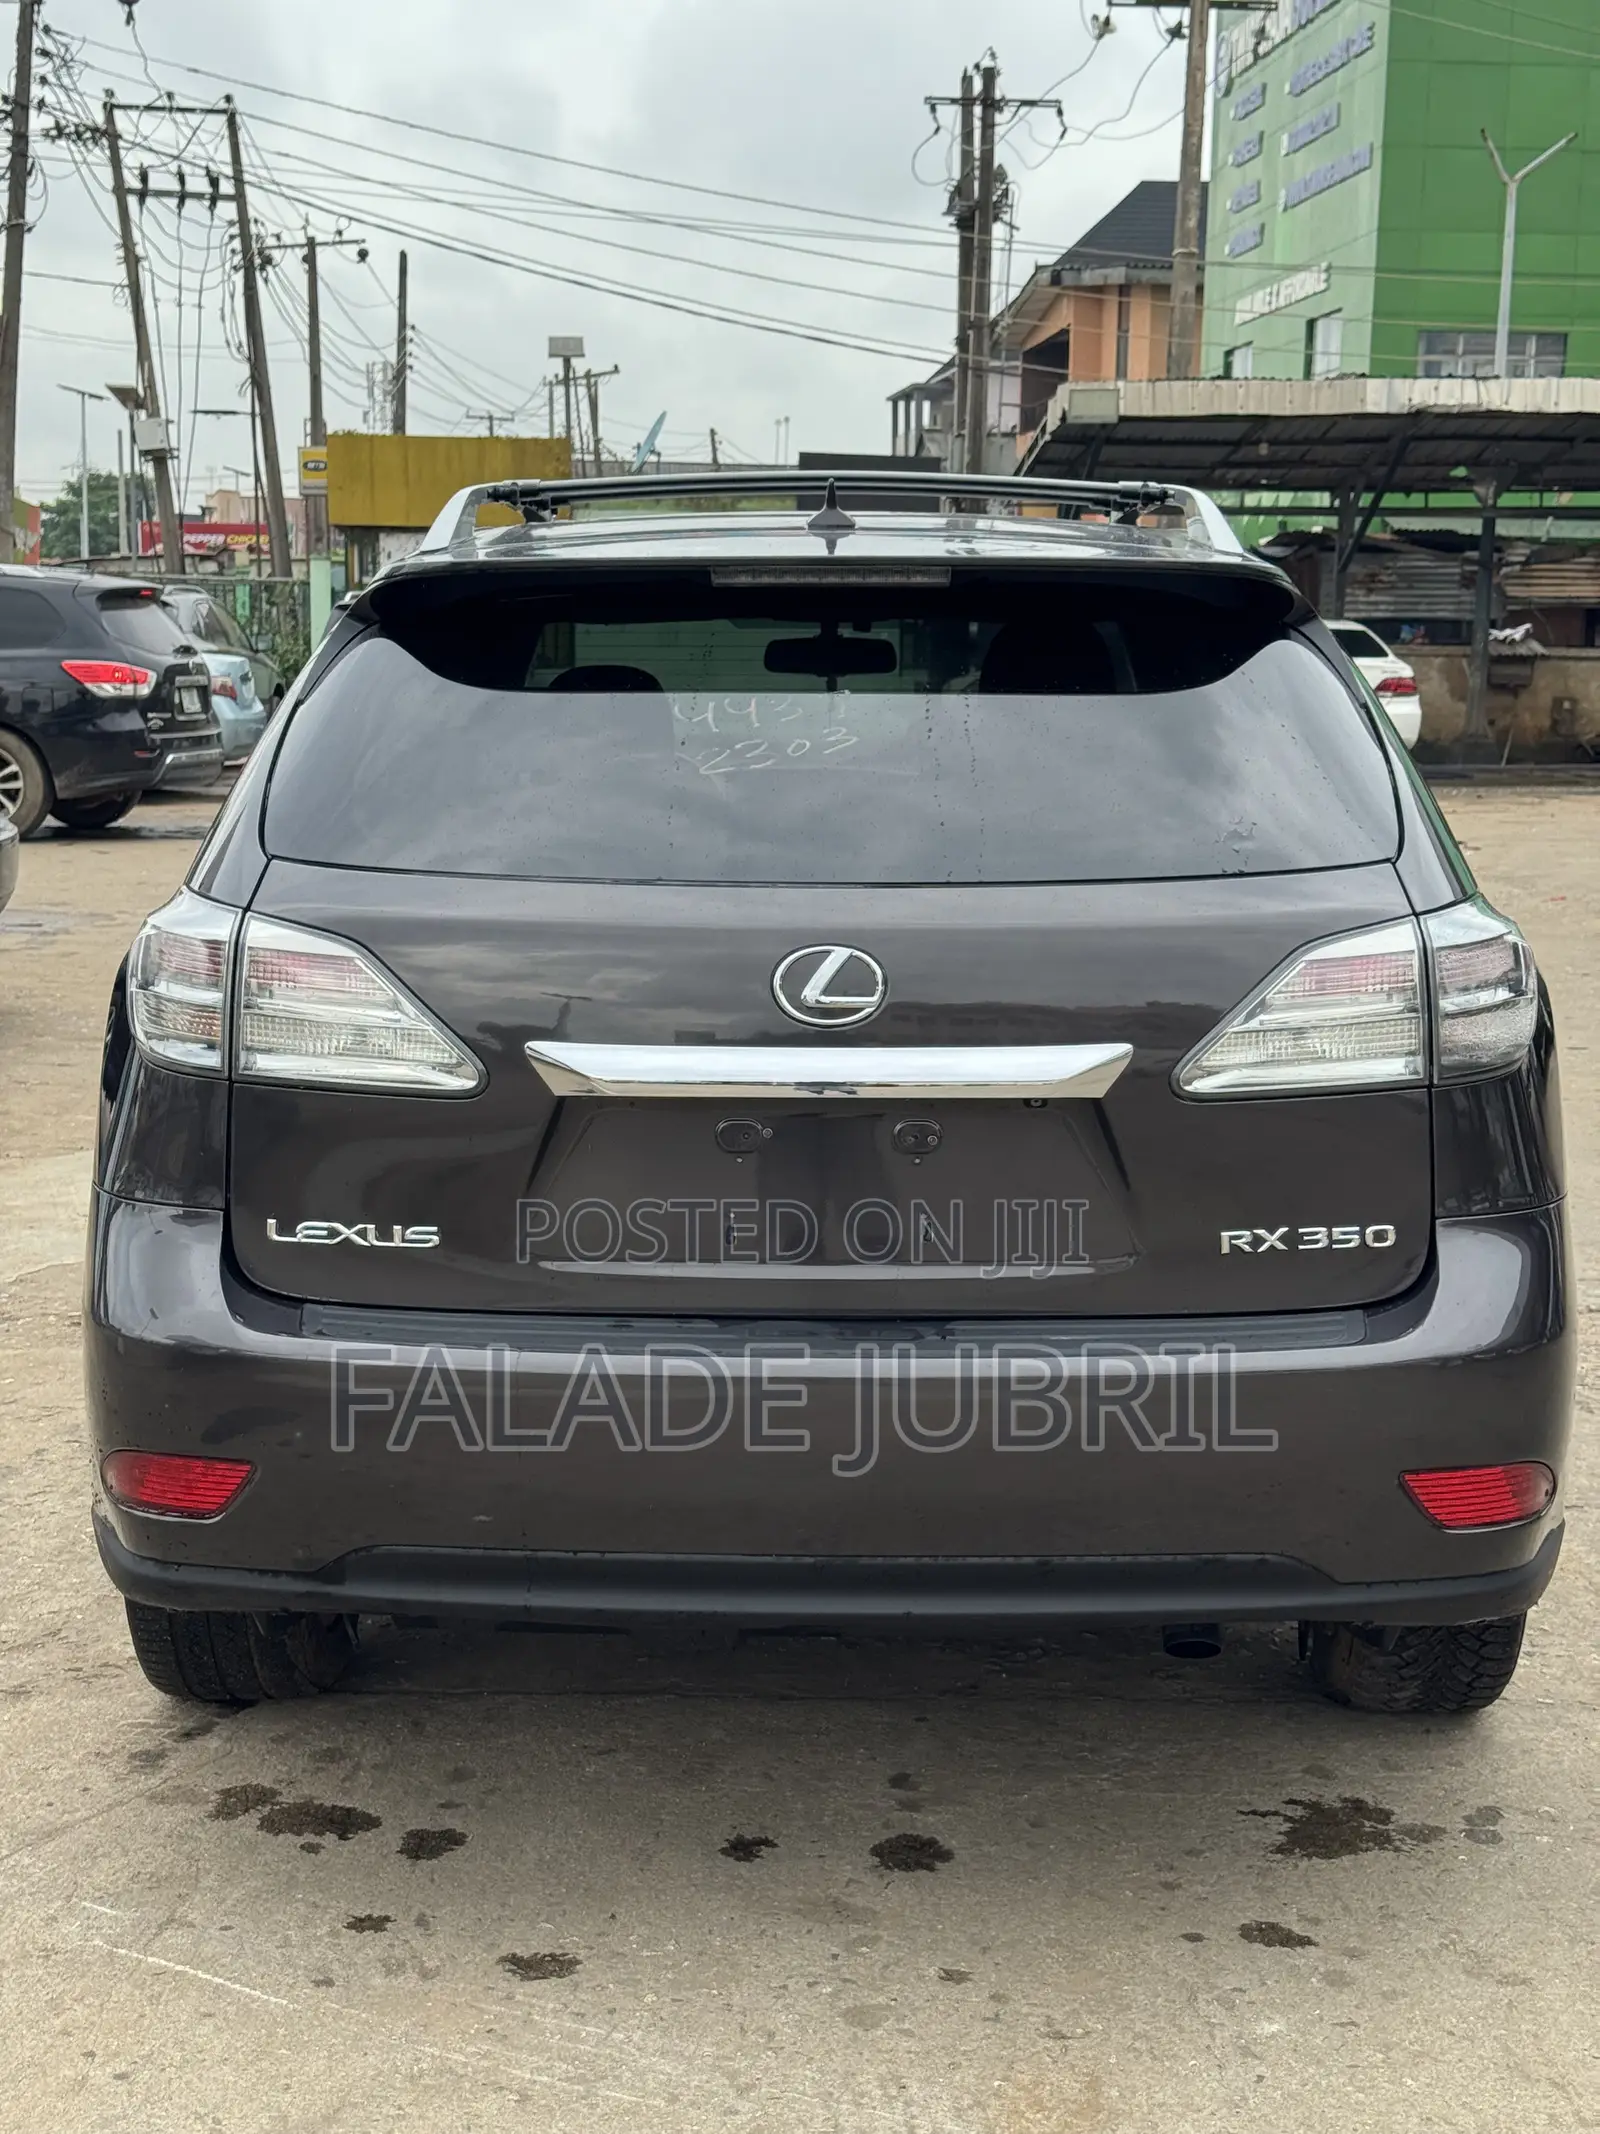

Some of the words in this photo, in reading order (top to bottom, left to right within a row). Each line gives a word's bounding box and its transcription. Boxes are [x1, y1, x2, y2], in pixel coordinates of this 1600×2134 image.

[267, 1218, 440, 1247] LEXUS
[1220, 1227, 1290, 1254] RX
[1298, 1224, 1397, 1250] 350
